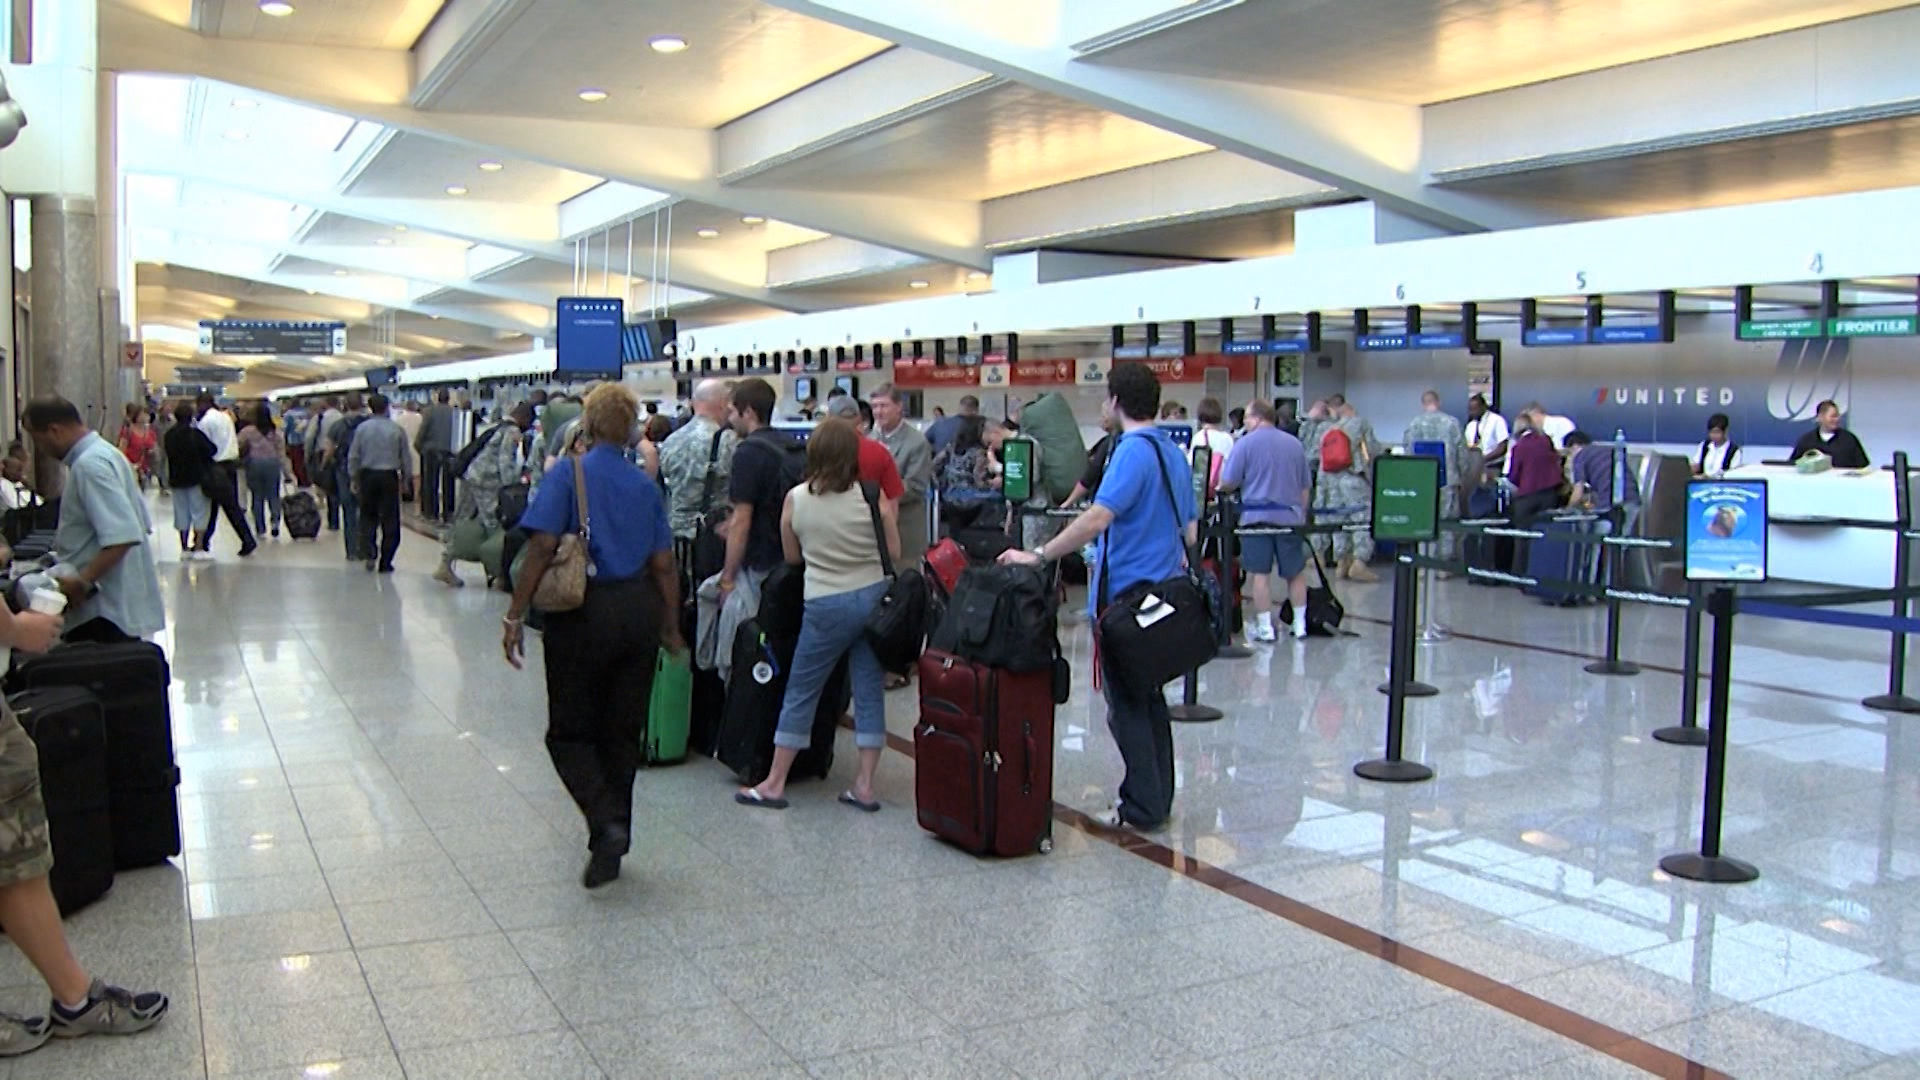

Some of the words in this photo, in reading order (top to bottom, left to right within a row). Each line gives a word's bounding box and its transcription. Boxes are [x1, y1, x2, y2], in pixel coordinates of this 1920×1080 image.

[1809, 253, 1823, 274] 4
[1576, 271, 1587, 289] 5
[1395, 283, 1405, 300] 6
[1253, 296, 1261, 310] 7
[1835, 319, 1909, 333] FRONTIER
[1615, 386, 1734, 406] UNITED
